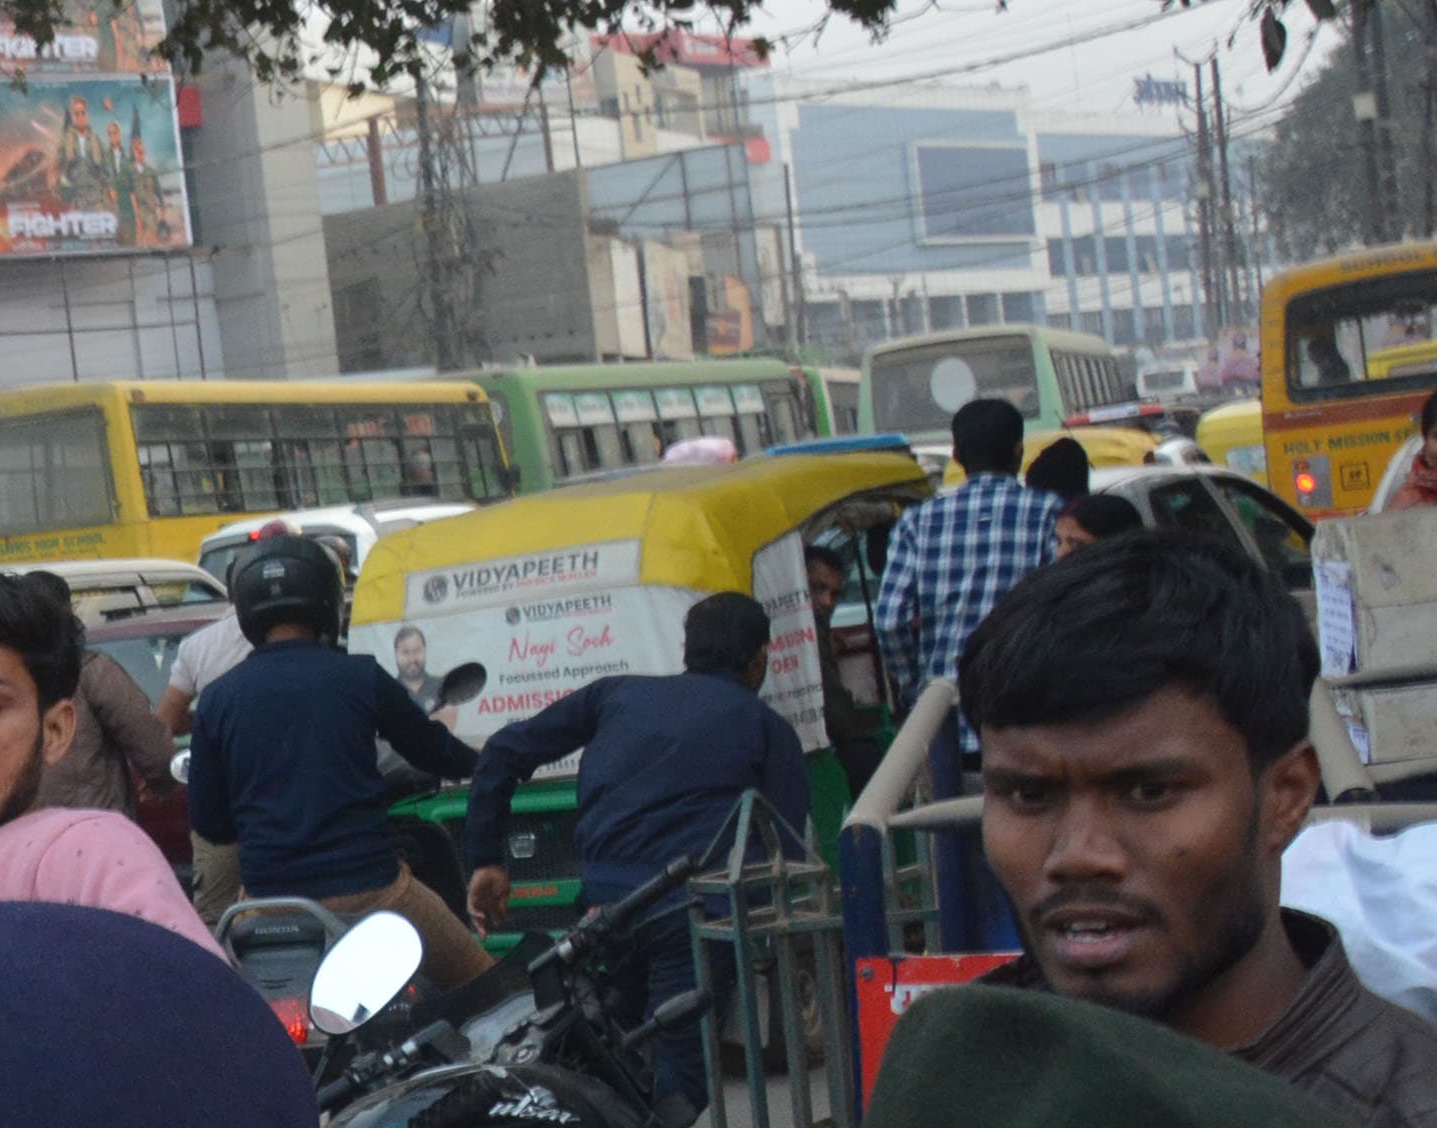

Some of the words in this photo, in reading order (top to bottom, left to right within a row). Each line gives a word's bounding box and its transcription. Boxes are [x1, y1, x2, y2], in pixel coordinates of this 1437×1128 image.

[7, 209, 119, 238] FIGHTER
[1283, 440, 1323, 455] HOLY
[1328, 430, 1392, 450] MISSION
[453, 551, 599, 591] VIDYAPEETH
[522, 594, 612, 617] VIDYAPEETH
[566, 623, 615, 657] Soch
[499, 665, 561, 685] Focussed
[563, 658, 630, 679] Approach
